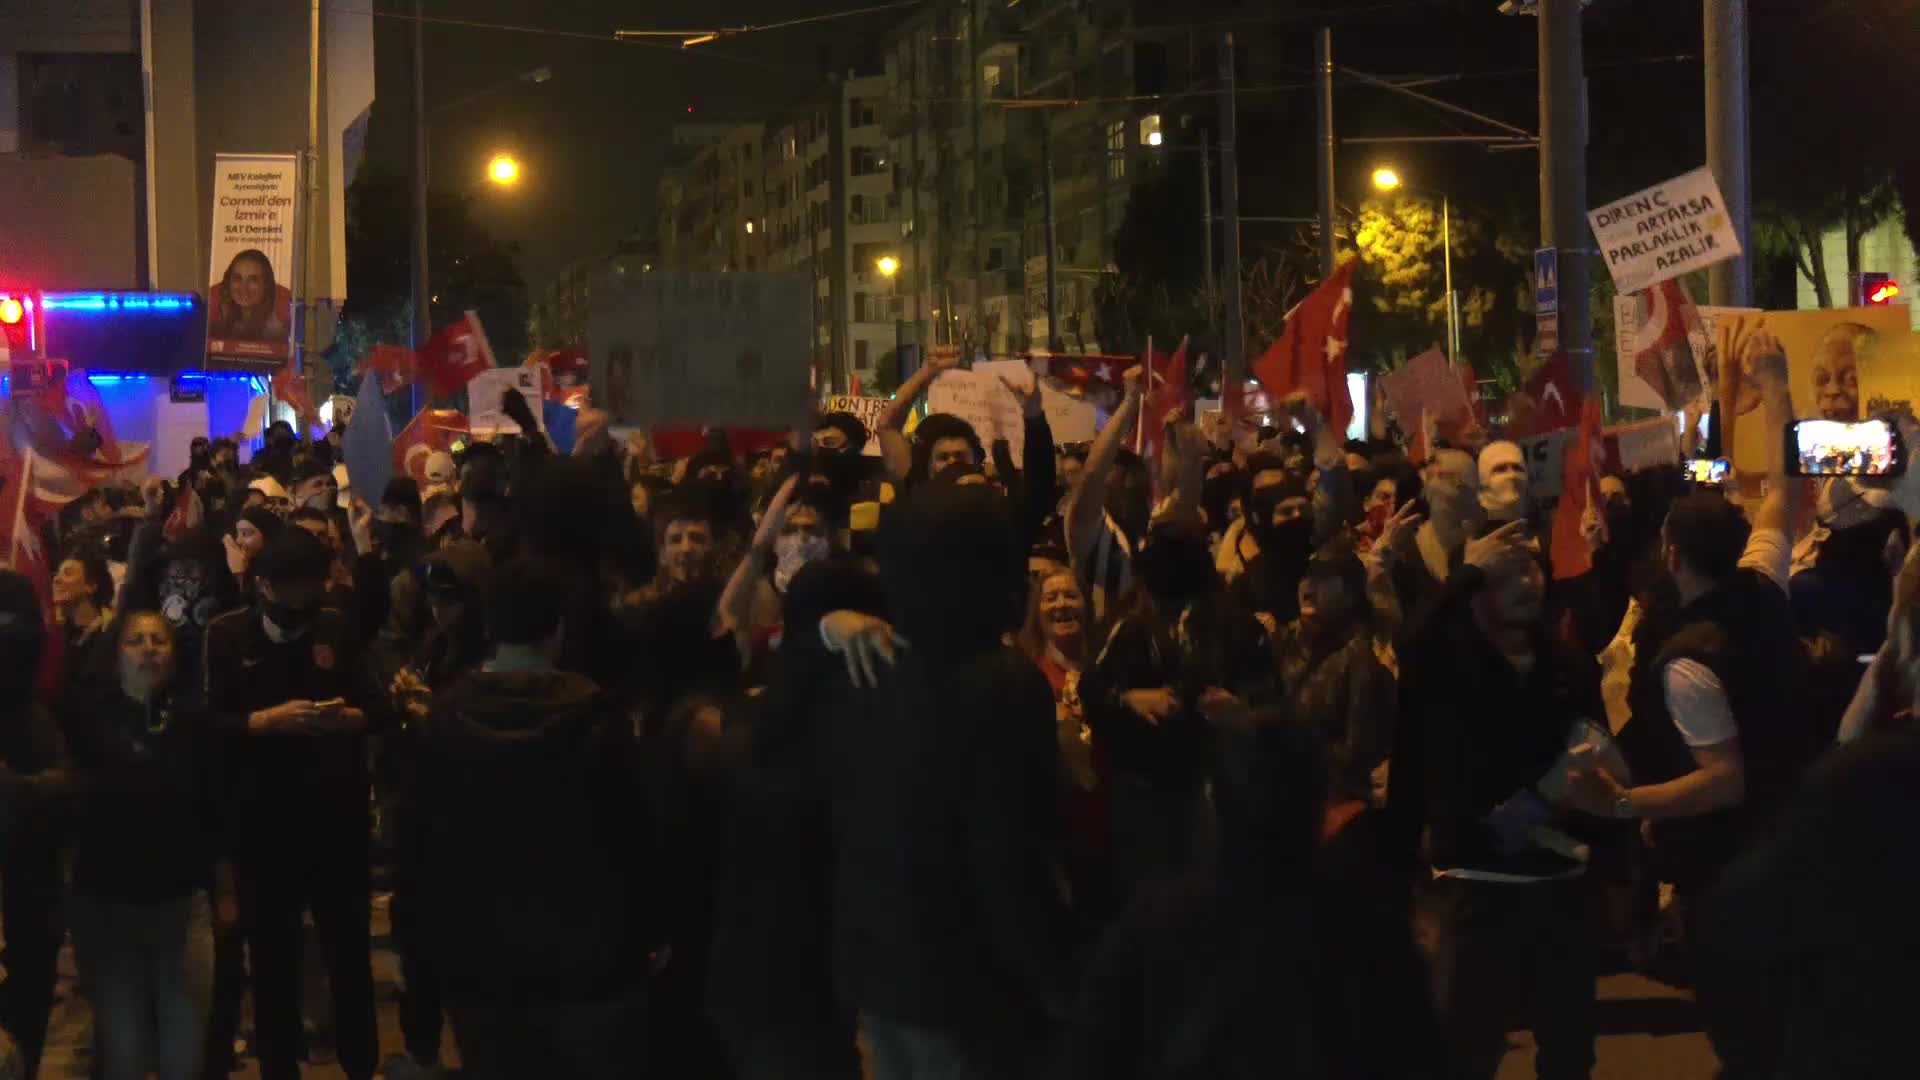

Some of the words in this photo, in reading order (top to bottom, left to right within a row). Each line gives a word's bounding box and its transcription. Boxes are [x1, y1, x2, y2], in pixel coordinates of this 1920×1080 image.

[220, 195, 292, 207] Cornell'den
[1636, 195, 1714, 235] ARTARSA
[224, 224, 245, 234] SAT
